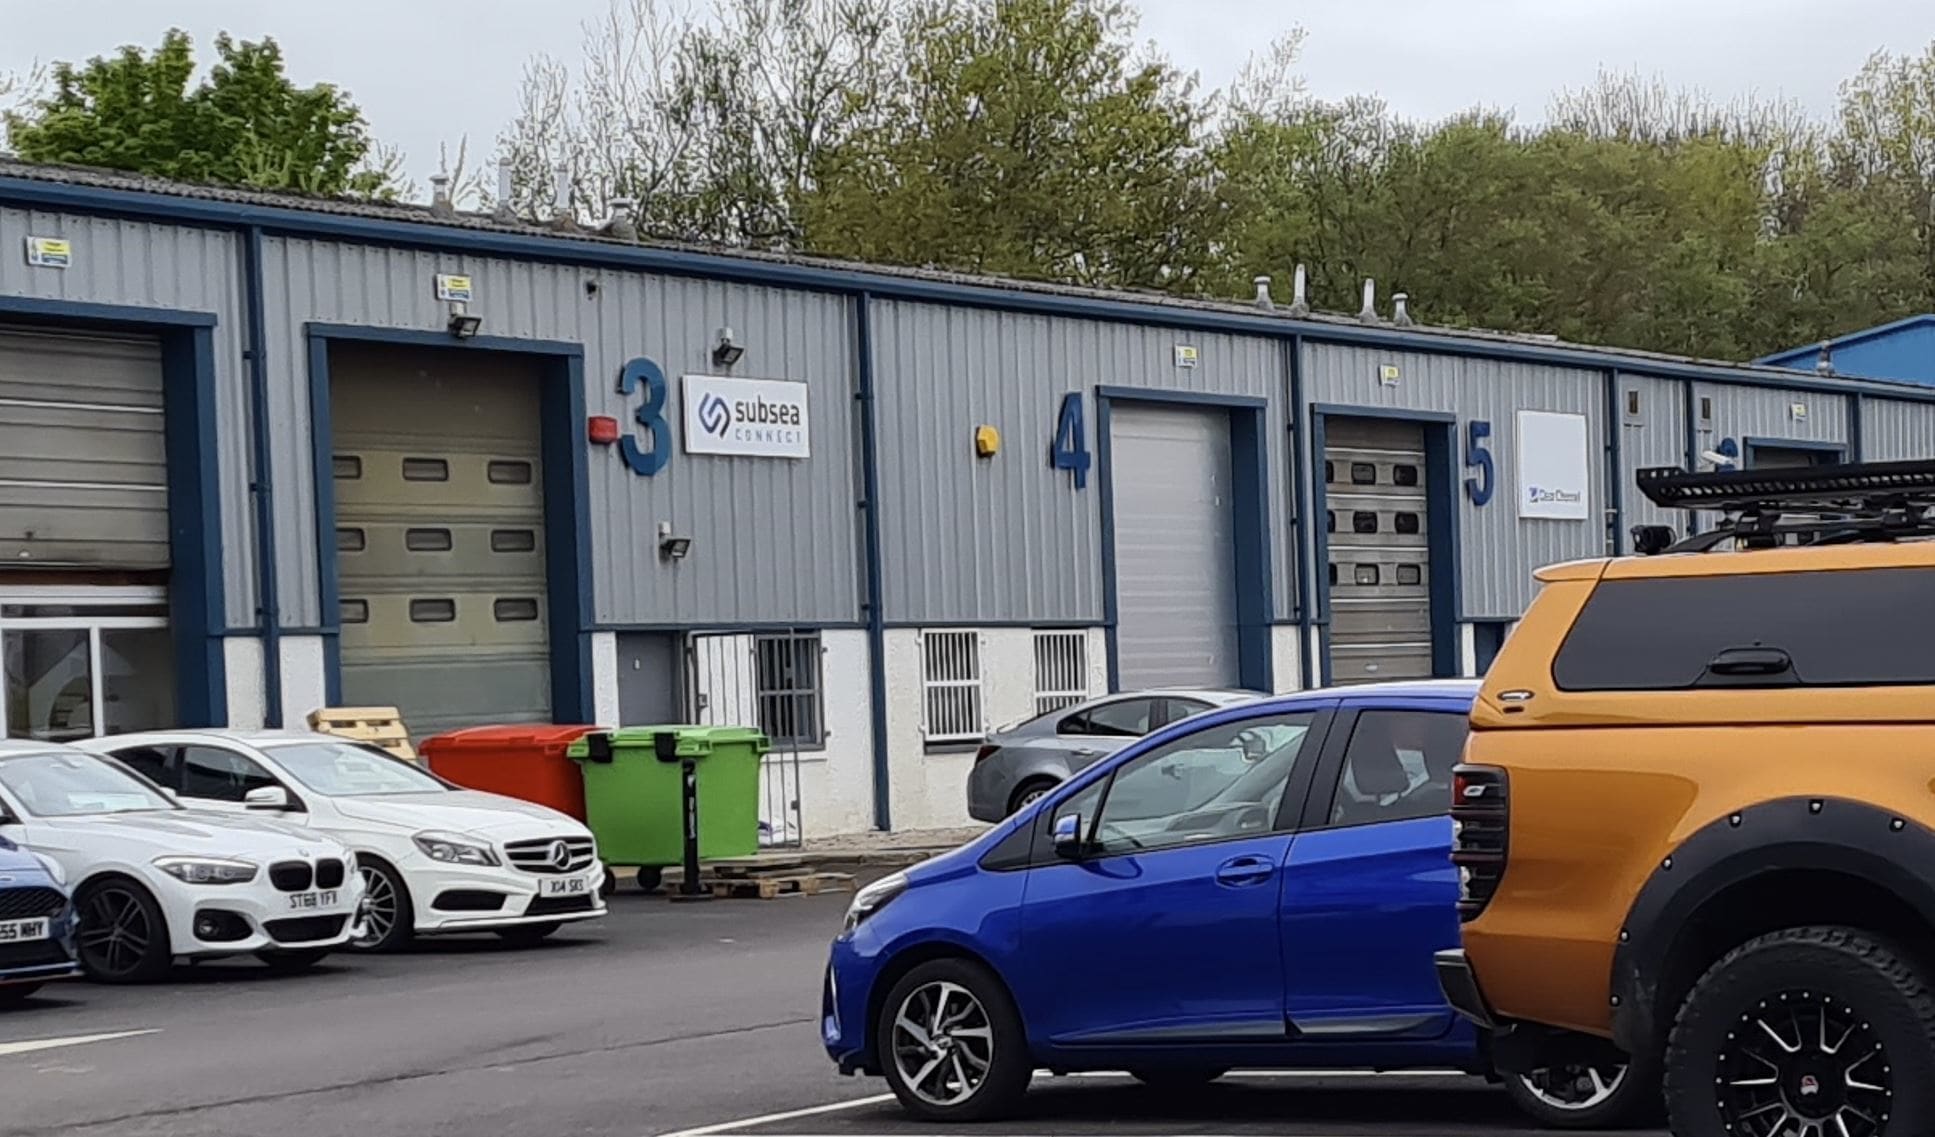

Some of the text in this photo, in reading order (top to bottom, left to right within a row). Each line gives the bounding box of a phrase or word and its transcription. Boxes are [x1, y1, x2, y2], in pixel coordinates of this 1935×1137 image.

[617, 357, 672, 477] 3
[734, 394, 801, 426] subsea
[735, 428, 802, 444] CONNECT
[1050, 392, 1091, 492] 4
[1465, 420, 1495, 507] 5
